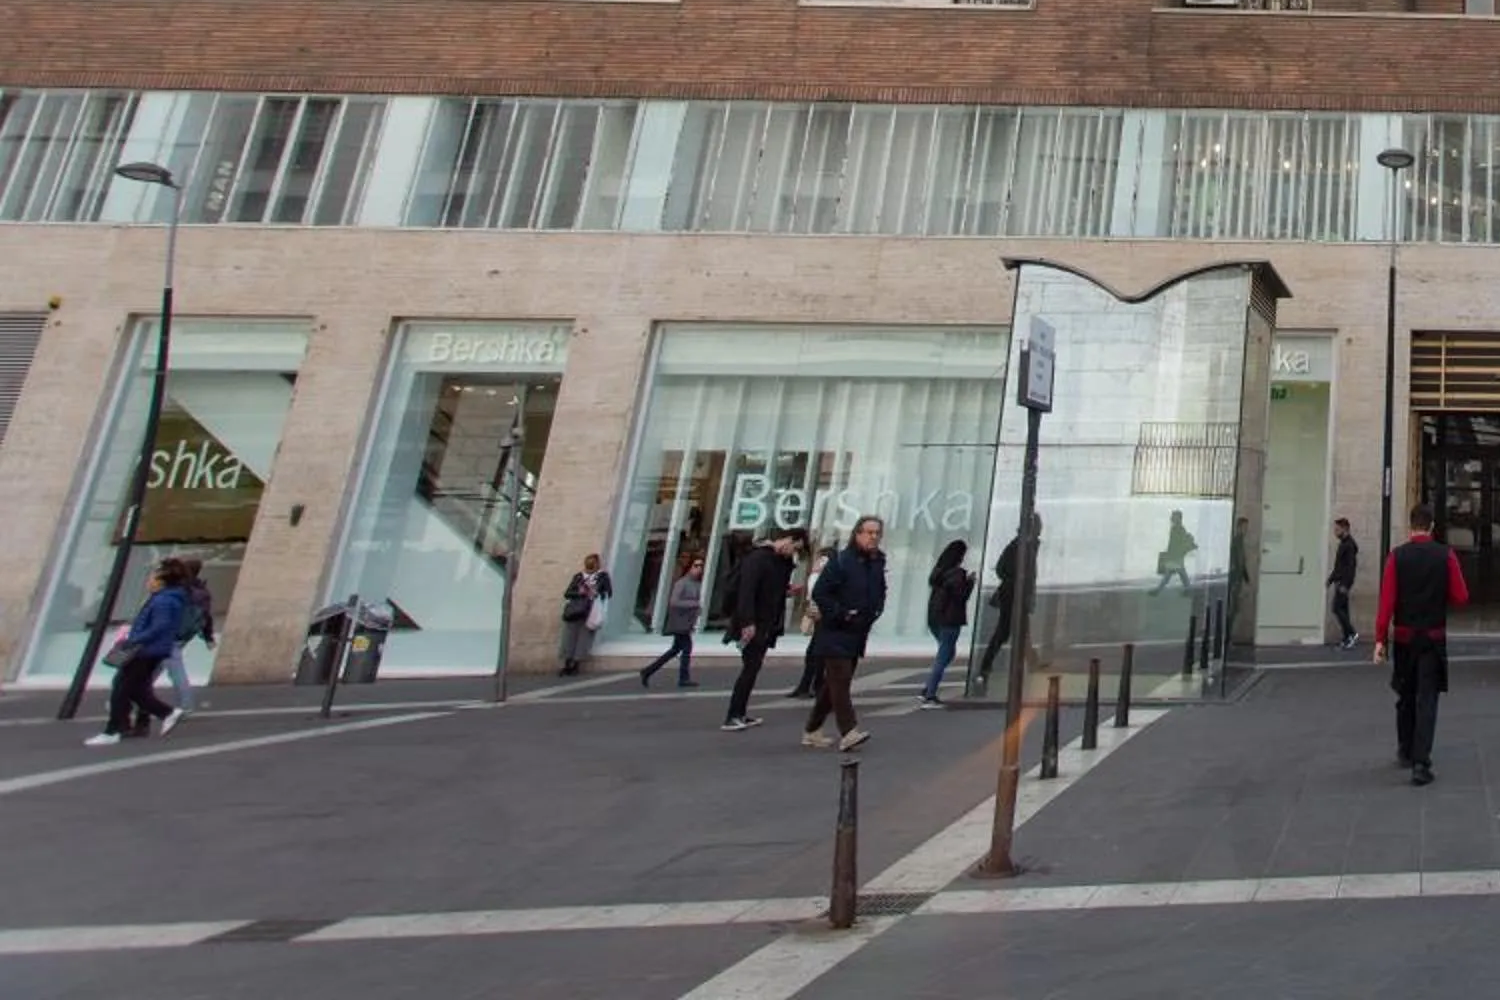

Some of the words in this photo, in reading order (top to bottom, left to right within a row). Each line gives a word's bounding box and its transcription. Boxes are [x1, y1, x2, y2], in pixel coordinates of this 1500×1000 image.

[429, 332, 556, 363] Bershka
[1274, 343, 1310, 373] ka
[146, 439, 241, 489] shka
[728, 472, 974, 531] Bershka
